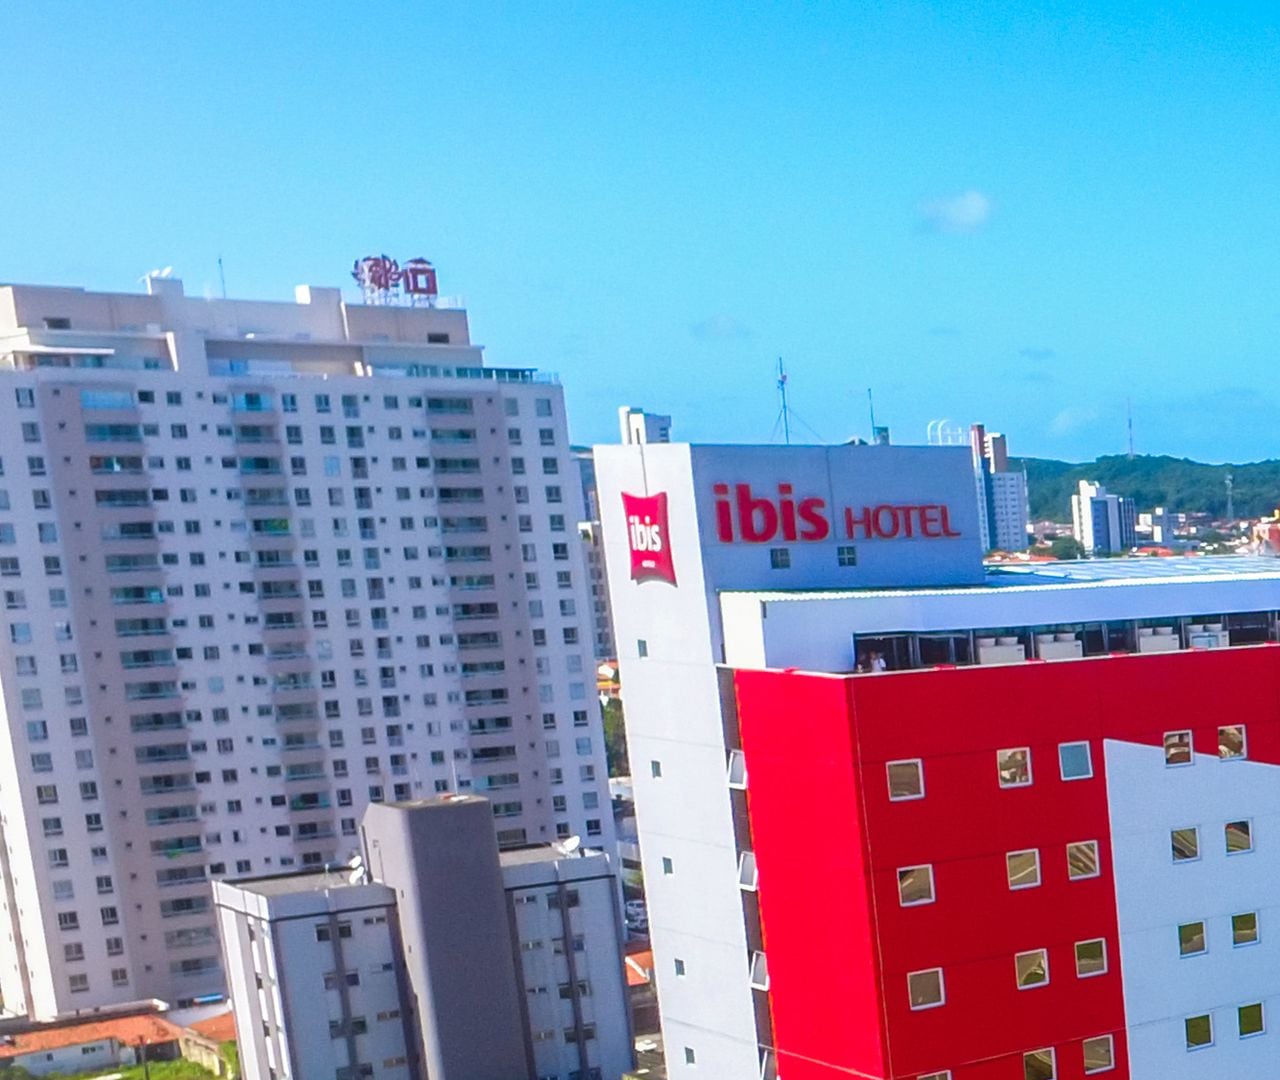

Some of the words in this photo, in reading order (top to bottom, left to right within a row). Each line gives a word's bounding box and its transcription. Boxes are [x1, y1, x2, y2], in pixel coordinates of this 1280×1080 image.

[629, 514, 662, 552] ibis
[713, 483, 829, 543] ibis
[844, 504, 961, 540] HOTEL
